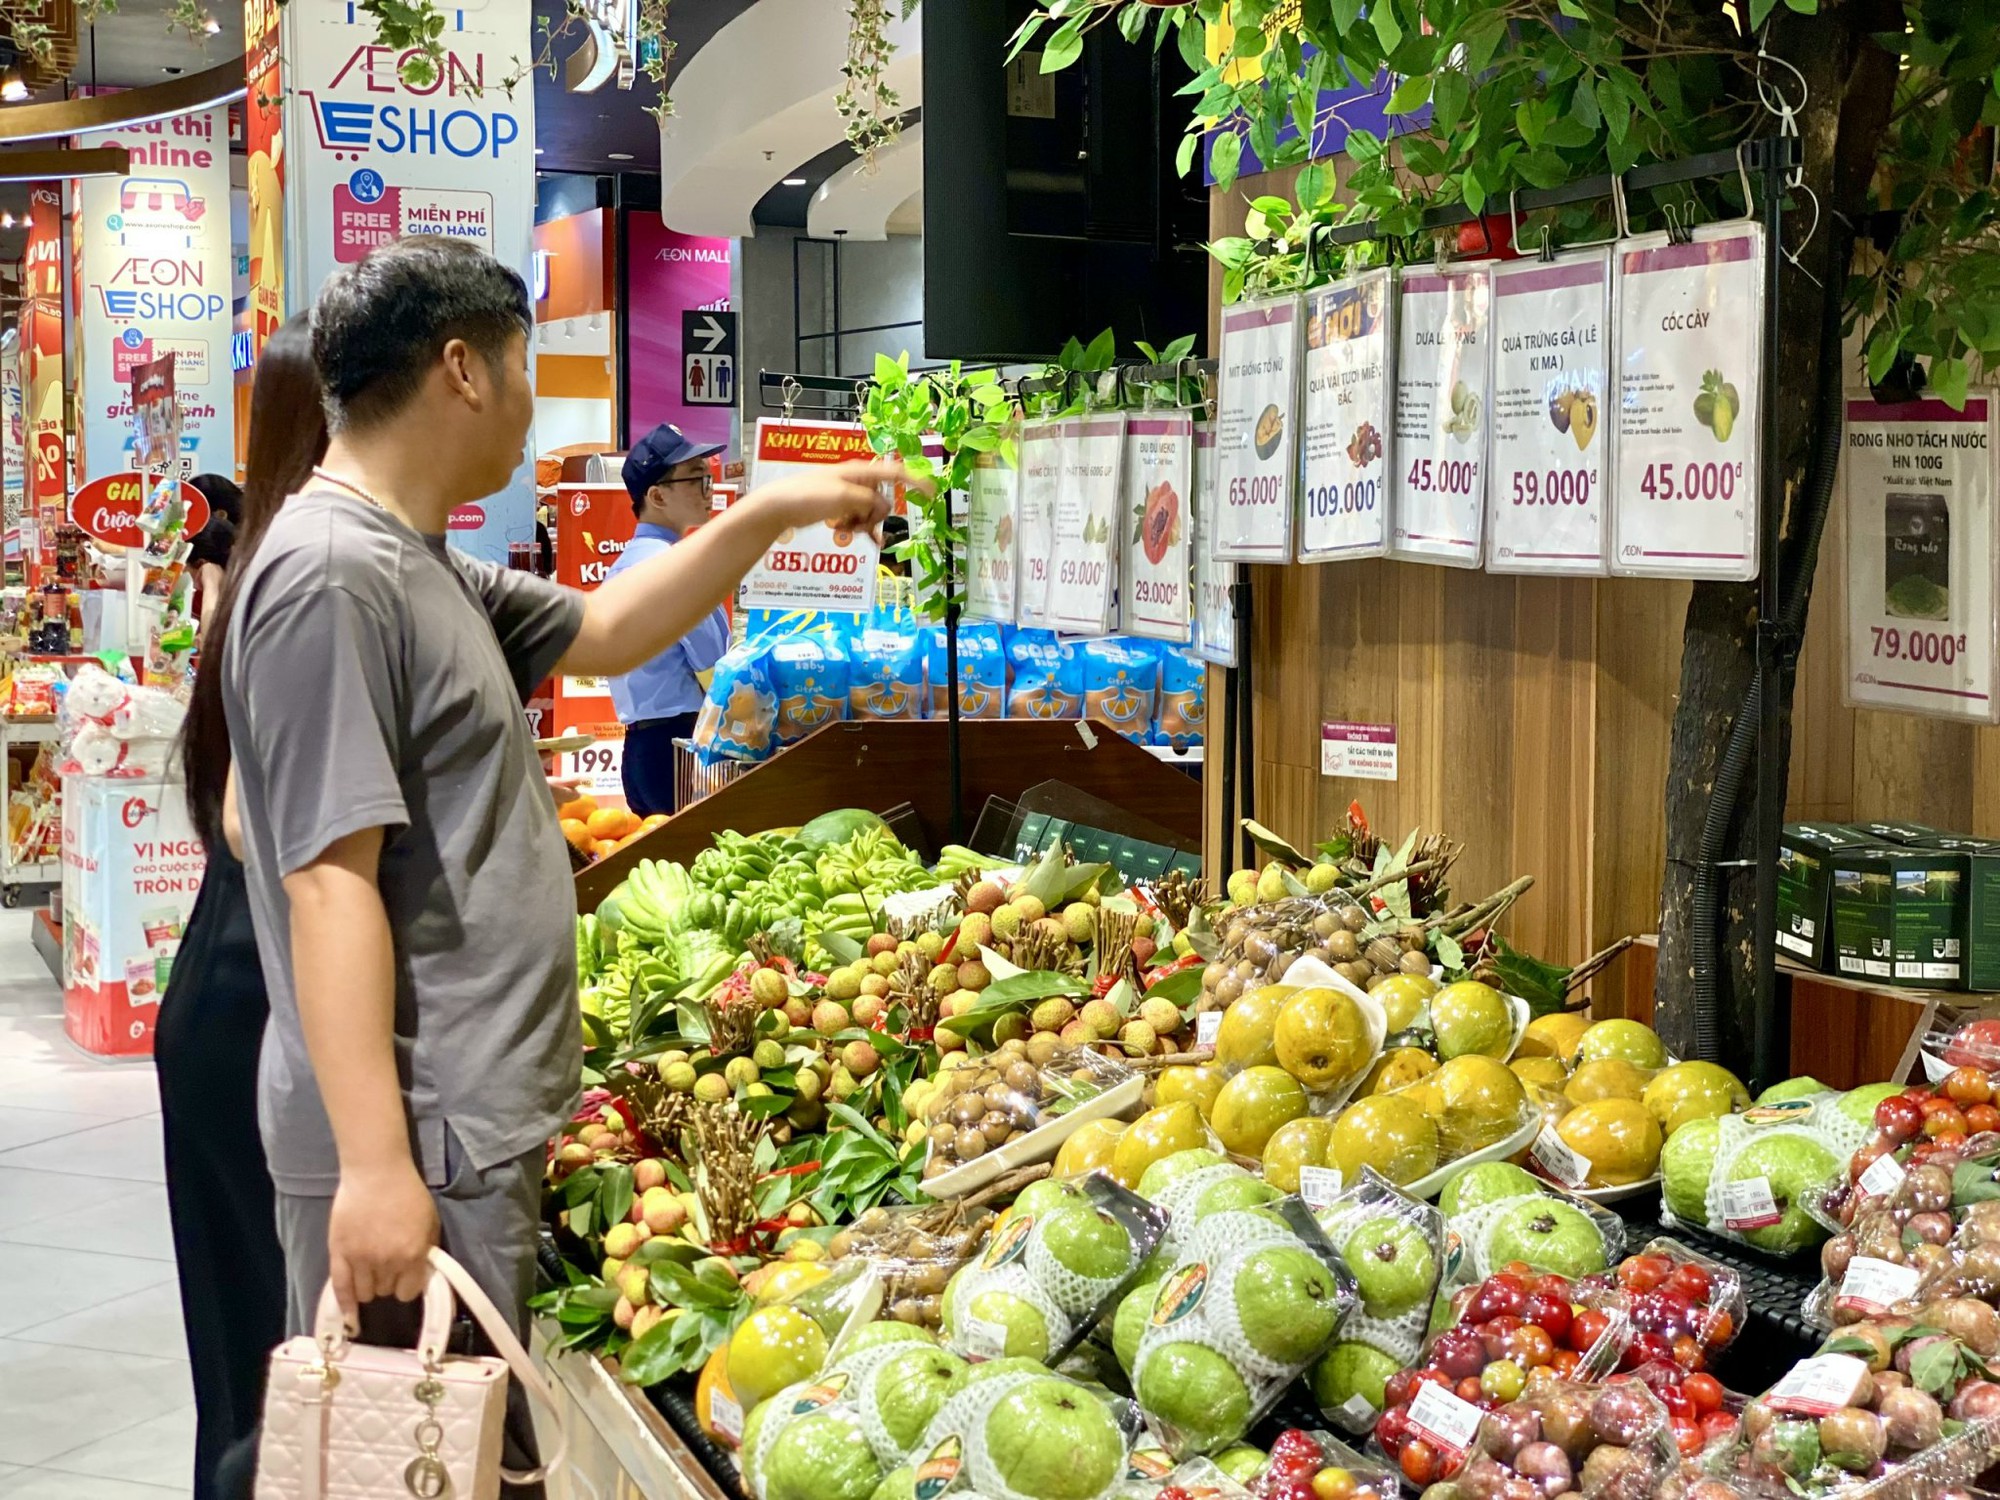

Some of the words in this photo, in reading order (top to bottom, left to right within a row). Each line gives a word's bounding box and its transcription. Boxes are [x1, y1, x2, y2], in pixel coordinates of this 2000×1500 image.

[171, 114, 212, 142] thị
[341, 212, 391, 227] FREE
[408, 204, 450, 222] MIỄN
[456, 207, 485, 223] PHÍ
[341, 230, 391, 245] SHIP
[408, 224, 442, 235] GIAO
[446, 223, 487, 236] HÀNG
[695, 249, 730, 263] MALL
[1662, 310, 1683, 331] CÓC
[1686, 308, 1709, 329] CÀY
[1416, 331, 1434, 345] DƯA
[1502, 332, 1521, 353] QUẢ
[1524, 330, 1558, 349] TRỨNG
[1561, 326, 1575, 345] GÀ
[1585, 323, 1597, 343] LÊ
[118, 353, 148, 362] FREE
[1530, 357, 1539, 371] KI
[1541, 355, 1558, 370] MA
[1310, 374, 1325, 393] QUẢ
[1327, 371, 1339, 388] VẢI
[1341, 369, 1360, 385] TƯƠI
[765, 431, 841, 451] KHUYẾN
[844, 437, 873, 457] MẠ
[1849, 433, 1883, 447] RONG
[1886, 434, 1914, 447] NHO
[1917, 430, 1947, 448] TÁCH
[1951, 431, 1987, 449] NƯỚC
[1893, 455, 1910, 468] HN
[1915, 455, 1943, 469] 100G
[1408, 459, 1477, 495] 45.000đ
[1640, 462, 1742, 500] 45.000đ
[1919, 476, 1933, 487] Việt
[1935, 477, 1952, 486] Nam
[1229, 475, 1282, 506] 65.000đ
[1512, 469, 1597, 506] 59.000đ
[1308, 477, 1381, 518] 109.000đ
[1030, 558, 1048, 580] 79.
[1136, 580, 1178, 604] 29.000đ
[1870, 626, 1967, 665] 79.000đ
[1034, 658, 1061, 669] Baby
[134, 843, 153, 861] VỊ
[134, 865, 157, 873] CHO
[159, 861, 189, 873] CUỘC
[134, 875, 182, 894] TRÒN
